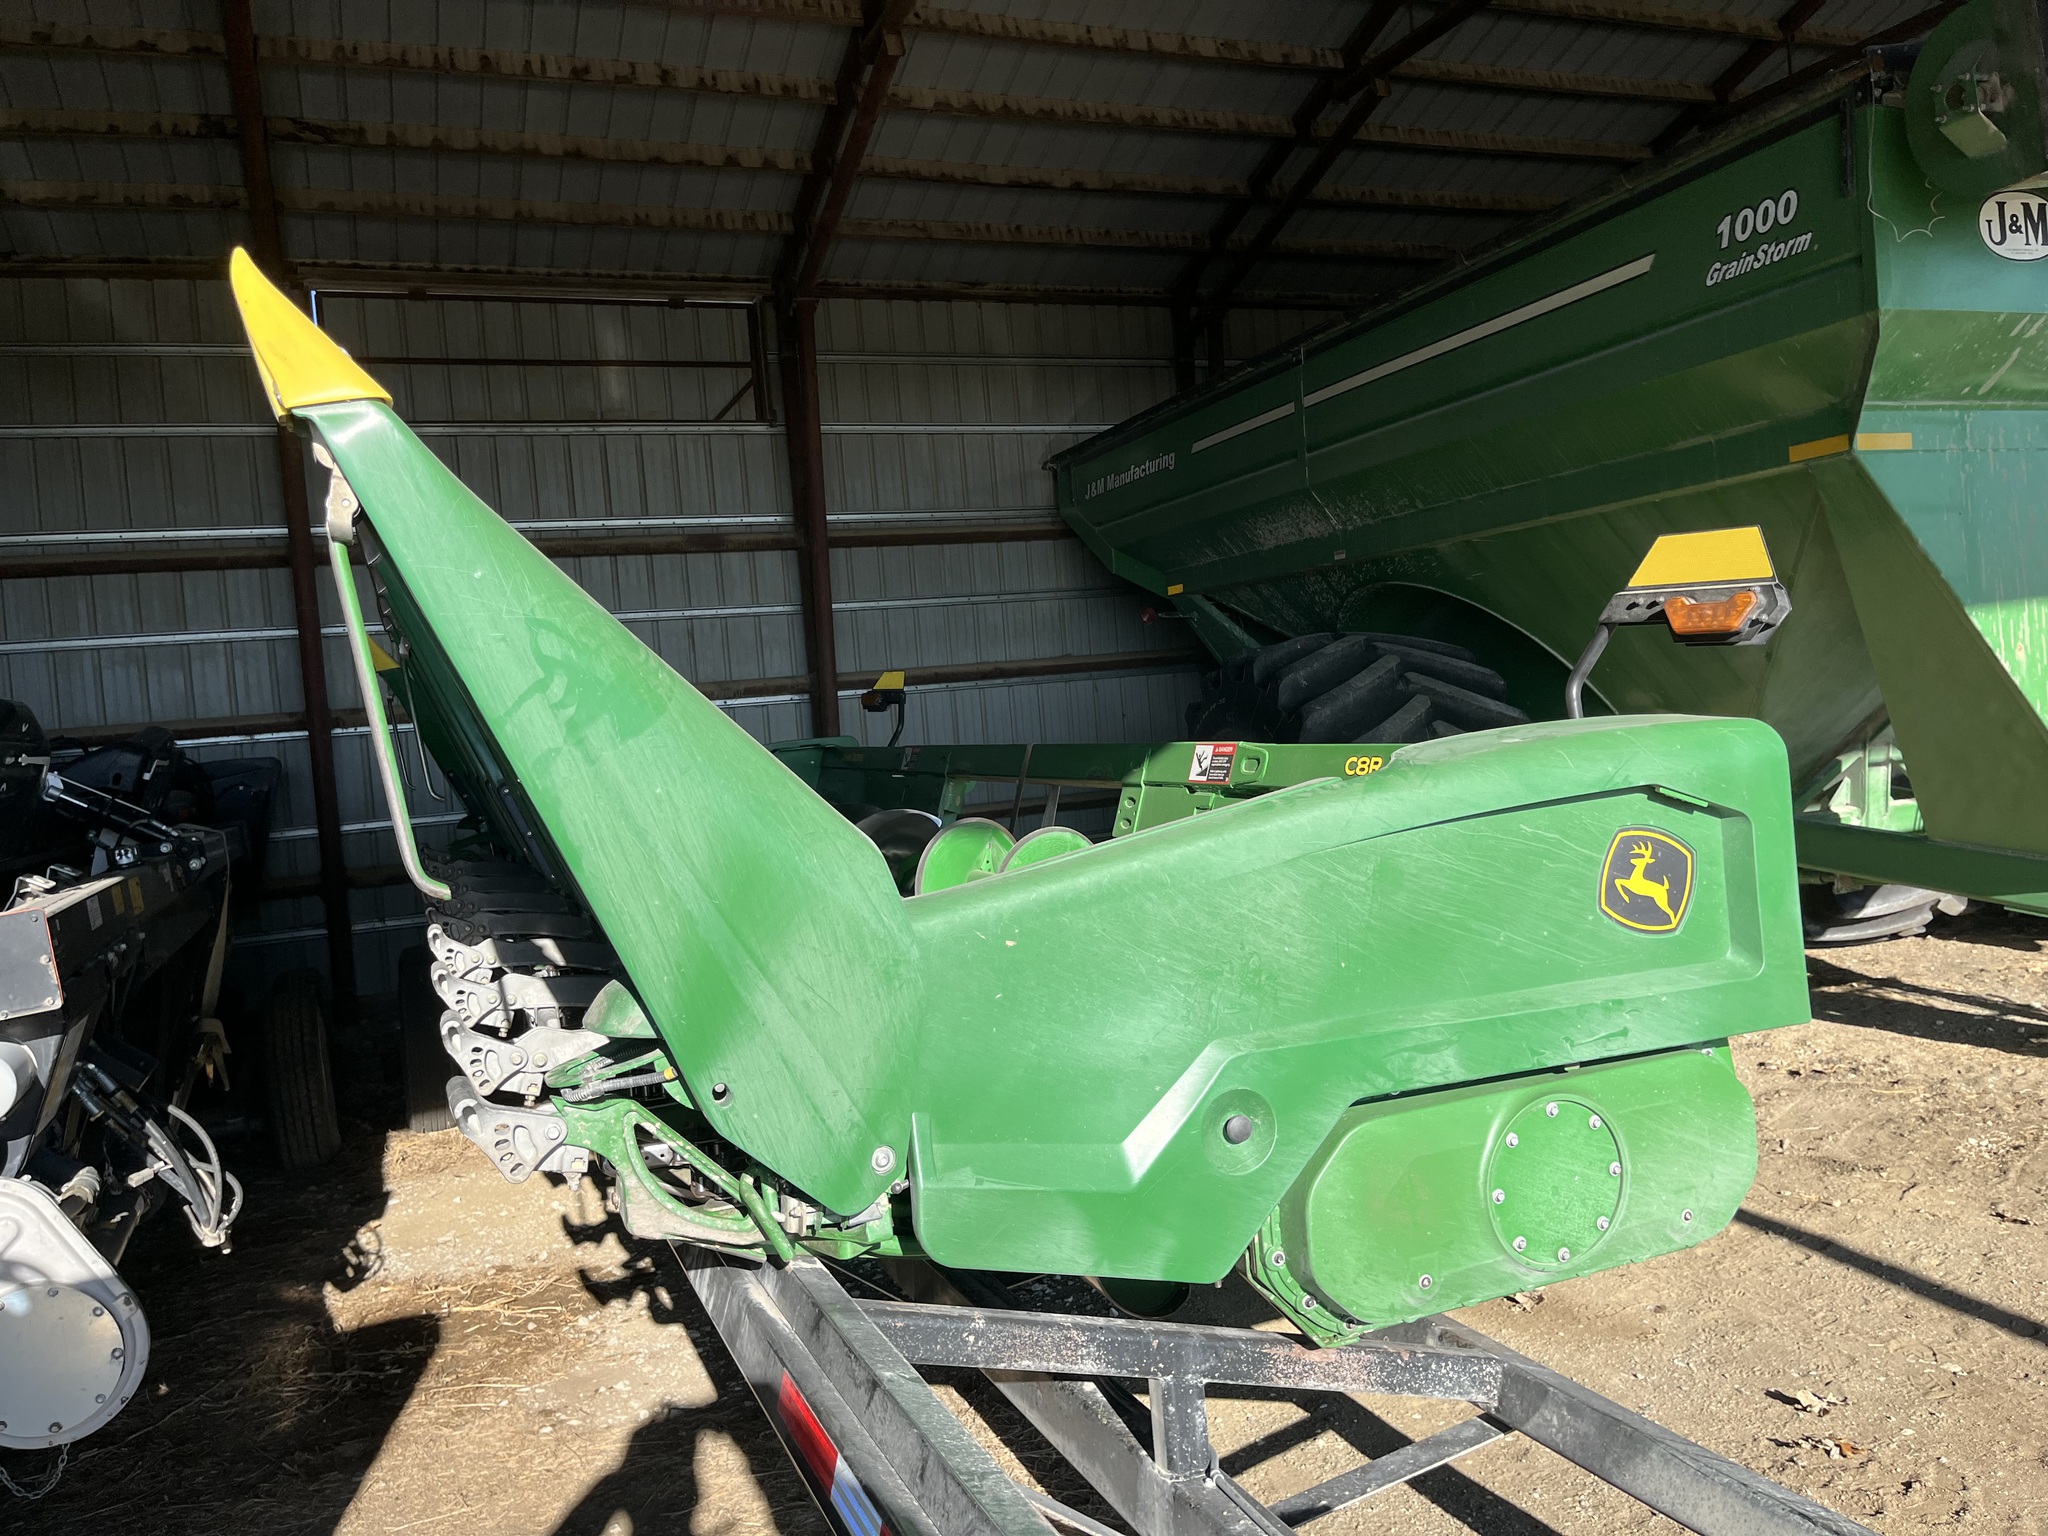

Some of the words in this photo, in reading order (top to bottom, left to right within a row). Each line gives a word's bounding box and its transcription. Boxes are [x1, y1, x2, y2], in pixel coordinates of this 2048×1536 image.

[1716, 189, 1799, 250] 1000
[1985, 201, 2048, 246] J&M
[1705, 231, 1812, 287] GrainStorm
[1085, 477, 1105, 500] J&M
[1106, 452, 1176, 491] Manufacturing
